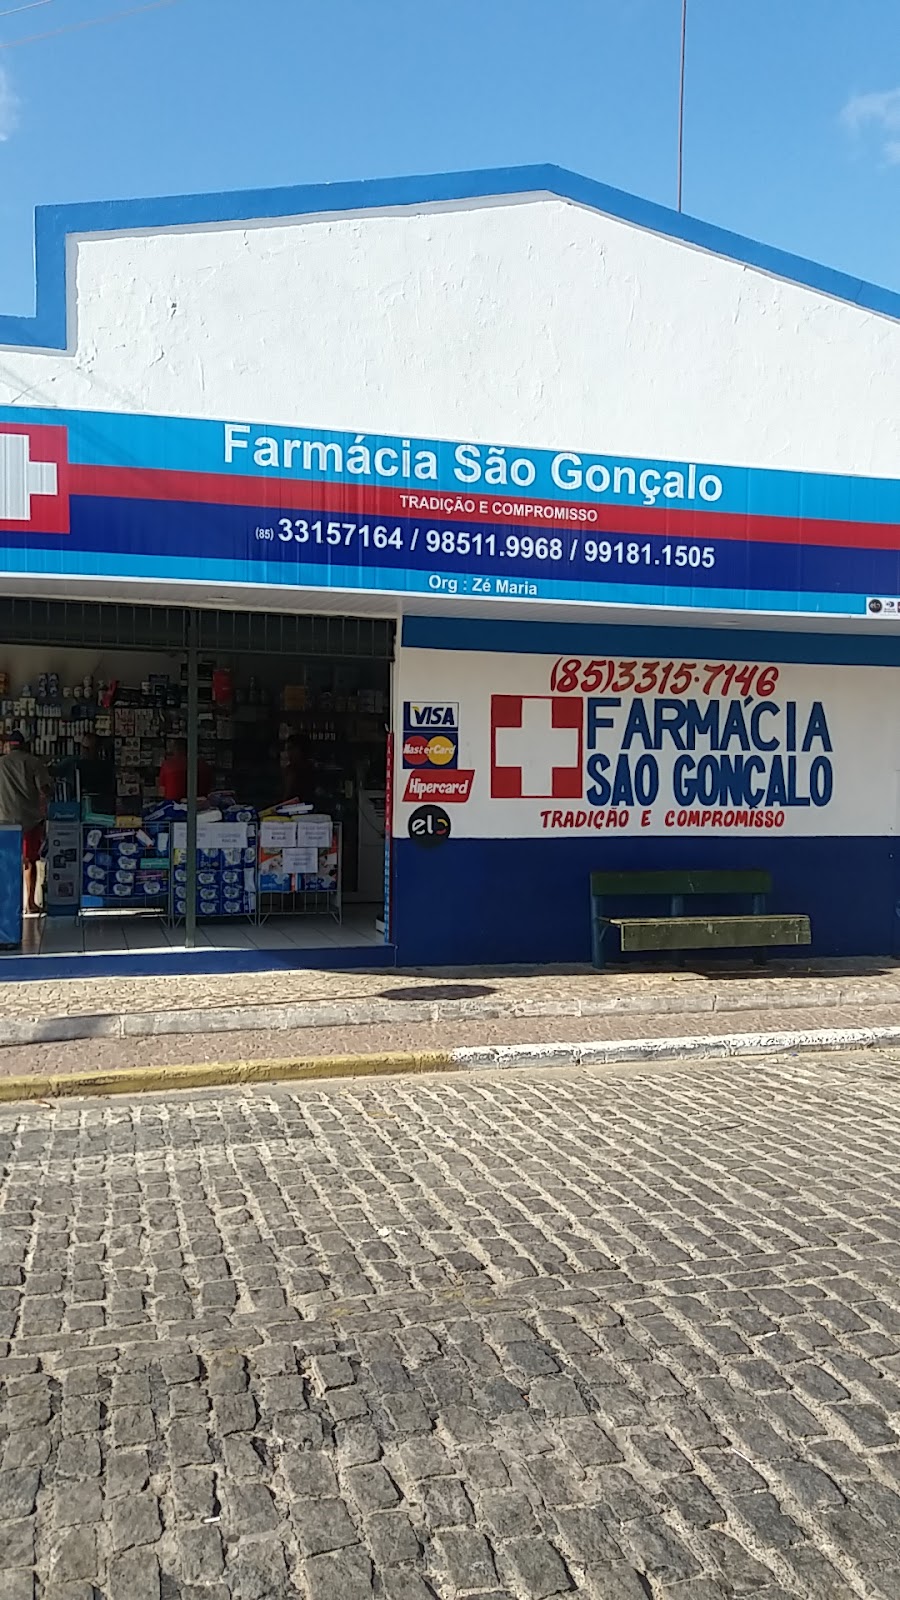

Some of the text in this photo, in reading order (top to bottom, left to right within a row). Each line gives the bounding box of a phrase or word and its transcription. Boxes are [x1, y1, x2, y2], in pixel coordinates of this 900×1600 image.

[224, 423, 723, 505] Farmácia São Gonçalo
[399, 494, 598, 522] TRADIÇÃO E COMPROMISSO
[255, 518, 715, 568] (85) 33157164 / 98511.9968 / 99181.1505
[428, 575, 458, 591] Org
[472, 577, 491, 592] Zé
[496, 579, 538, 595] Maria
[412, 706, 455, 726] VISA
[587, 695, 833, 752] FARMÁCIA
[409, 777, 469, 799] Hipercard
[673, 754, 833, 809] GONÇALO
[411, 815, 448, 835] elo
[540, 807, 785, 829] TRADIÇÃO E COMPROMISSO
